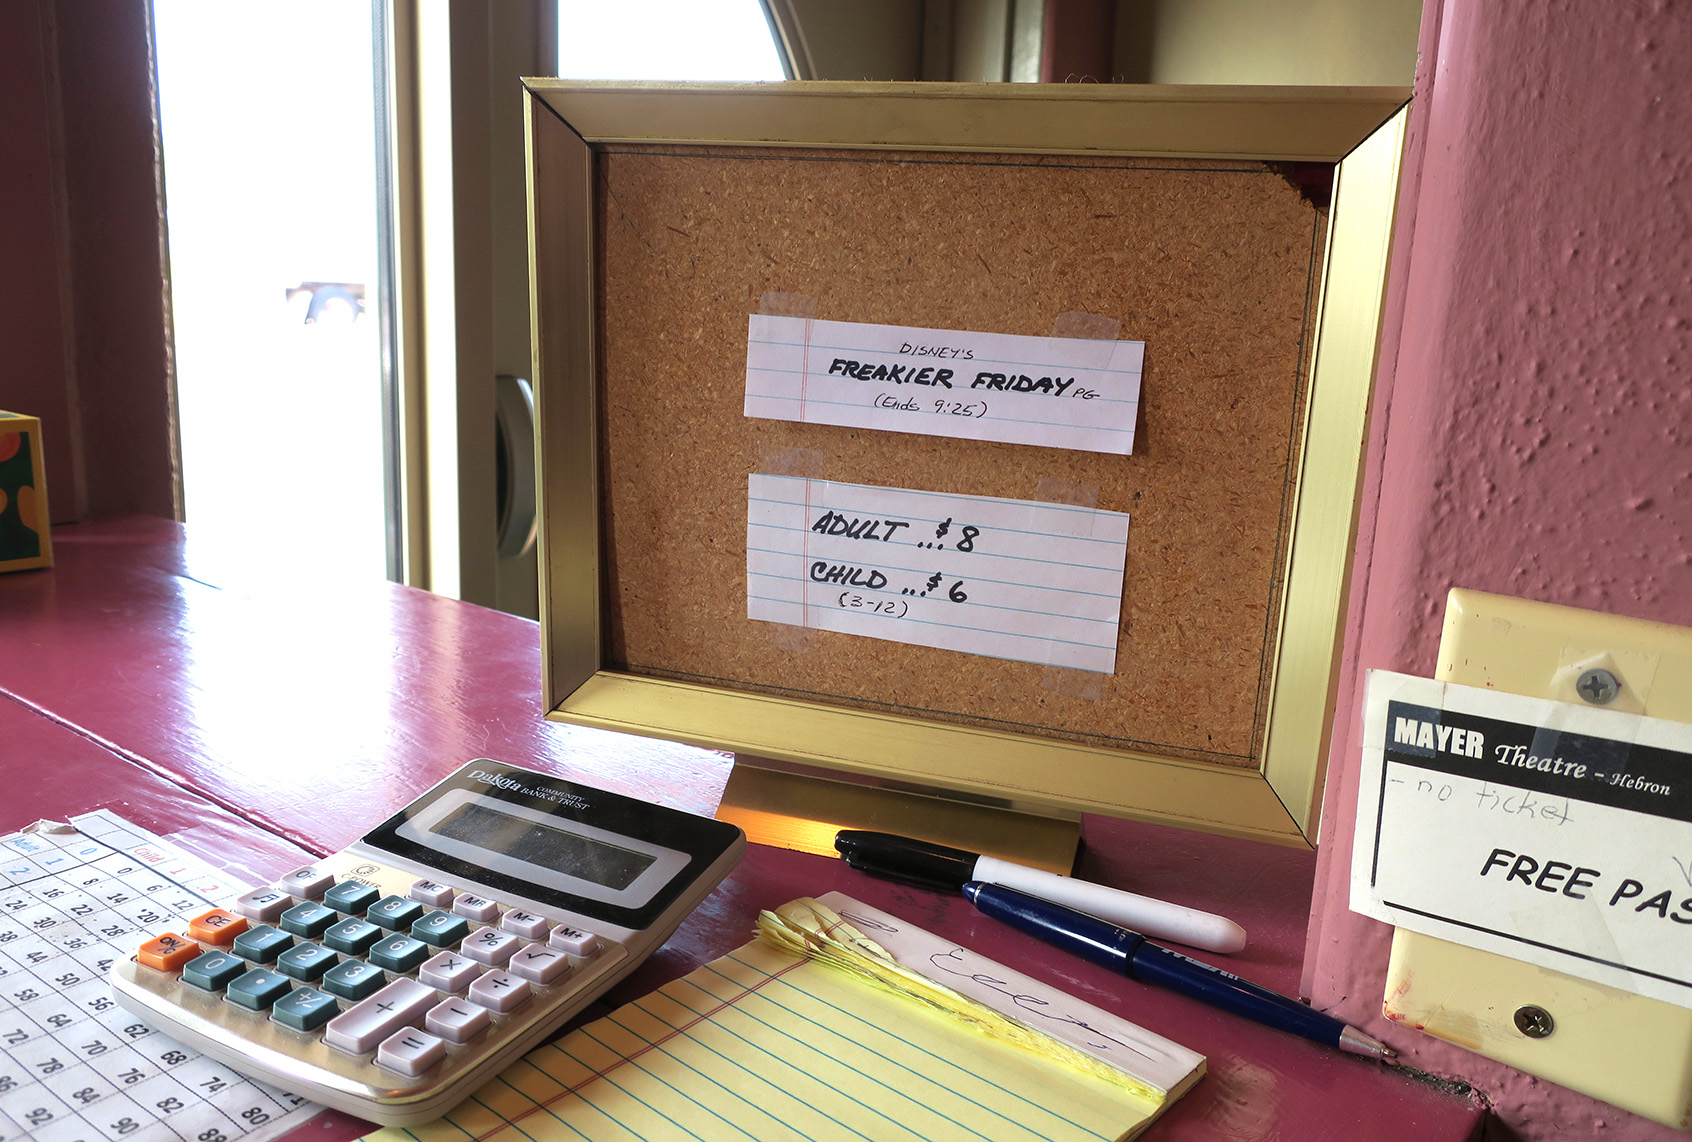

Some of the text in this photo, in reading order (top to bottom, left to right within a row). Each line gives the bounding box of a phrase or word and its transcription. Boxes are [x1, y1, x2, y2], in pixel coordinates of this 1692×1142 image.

[899, 342, 974, 361] DISNEY'S
[828, 358, 1101, 400] FREAKIER FRIDAY PG
[874, 392, 989, 419] (Ends 9:25)
[811, 510, 909, 543] ADULT
[810, 560, 888, 590] CHILD
[838, 591, 909, 619] (3-12)
[1394, 716, 1486, 760] MAYER
[1494, 744, 1588, 780] Theatre
[1609, 772, 1672, 796] Hebron
[467, 770, 522, 791] Dakota
[520, 787, 550, 800] BANK
[557, 797, 591, 811] TRUST
[536, 786, 585, 801] COMMUNITY
[1417, 780, 1453, 802] no
[1476, 781, 1575, 826] ticket
[134, 847, 165, 863] Child
[1480, 848, 1601, 900] FREE
[341, 885, 361, 895] 7
[419, 880, 444, 893] MC
[83, 878, 99, 886] 8
[106, 893, 129, 904] 14
[137, 910, 160, 923] 20
[172, 900, 194, 911] 12
[383, 901, 403, 911] 8
[463, 896, 487, 908] MR
[42, 888, 65, 898] 16
[70, 903, 94, 916] 22
[100, 924, 125, 937] 28
[205, 914, 231, 928] CE
[299, 908, 318, 918] 4
[429, 916, 448, 927] 9
[5, 899, 28, 910] 24
[33, 916, 57, 929] 30
[63, 937, 88, 949] 36
[342, 923, 363, 934] 5
[560, 927, 584, 940] M+
[295, 949, 318, 961] 2
[389, 940, 409, 951] 6
[204, 957, 226, 971] 0
[344, 966, 366, 978] 3
[26, 951, 49, 963] 44
[55, 972, 81, 986] 50
[88, 996, 115, 1011] 56
[123, 1023, 150, 1038] 62
[160, 1050, 188, 1065] 68
[199, 1076, 227, 1093] 74
[241, 1106, 271, 1125] 80
[13, 988, 40, 1002] 58
[46, 1013, 72, 1028] 64
[81, 1039, 108, 1056] 70
[117, 1067, 146, 1084] 76
[156, 1096, 185, 1114] 82
[2, 1028, 140, 1135] 72 78 84 90
[25, 1107, 54, 1126] 92
